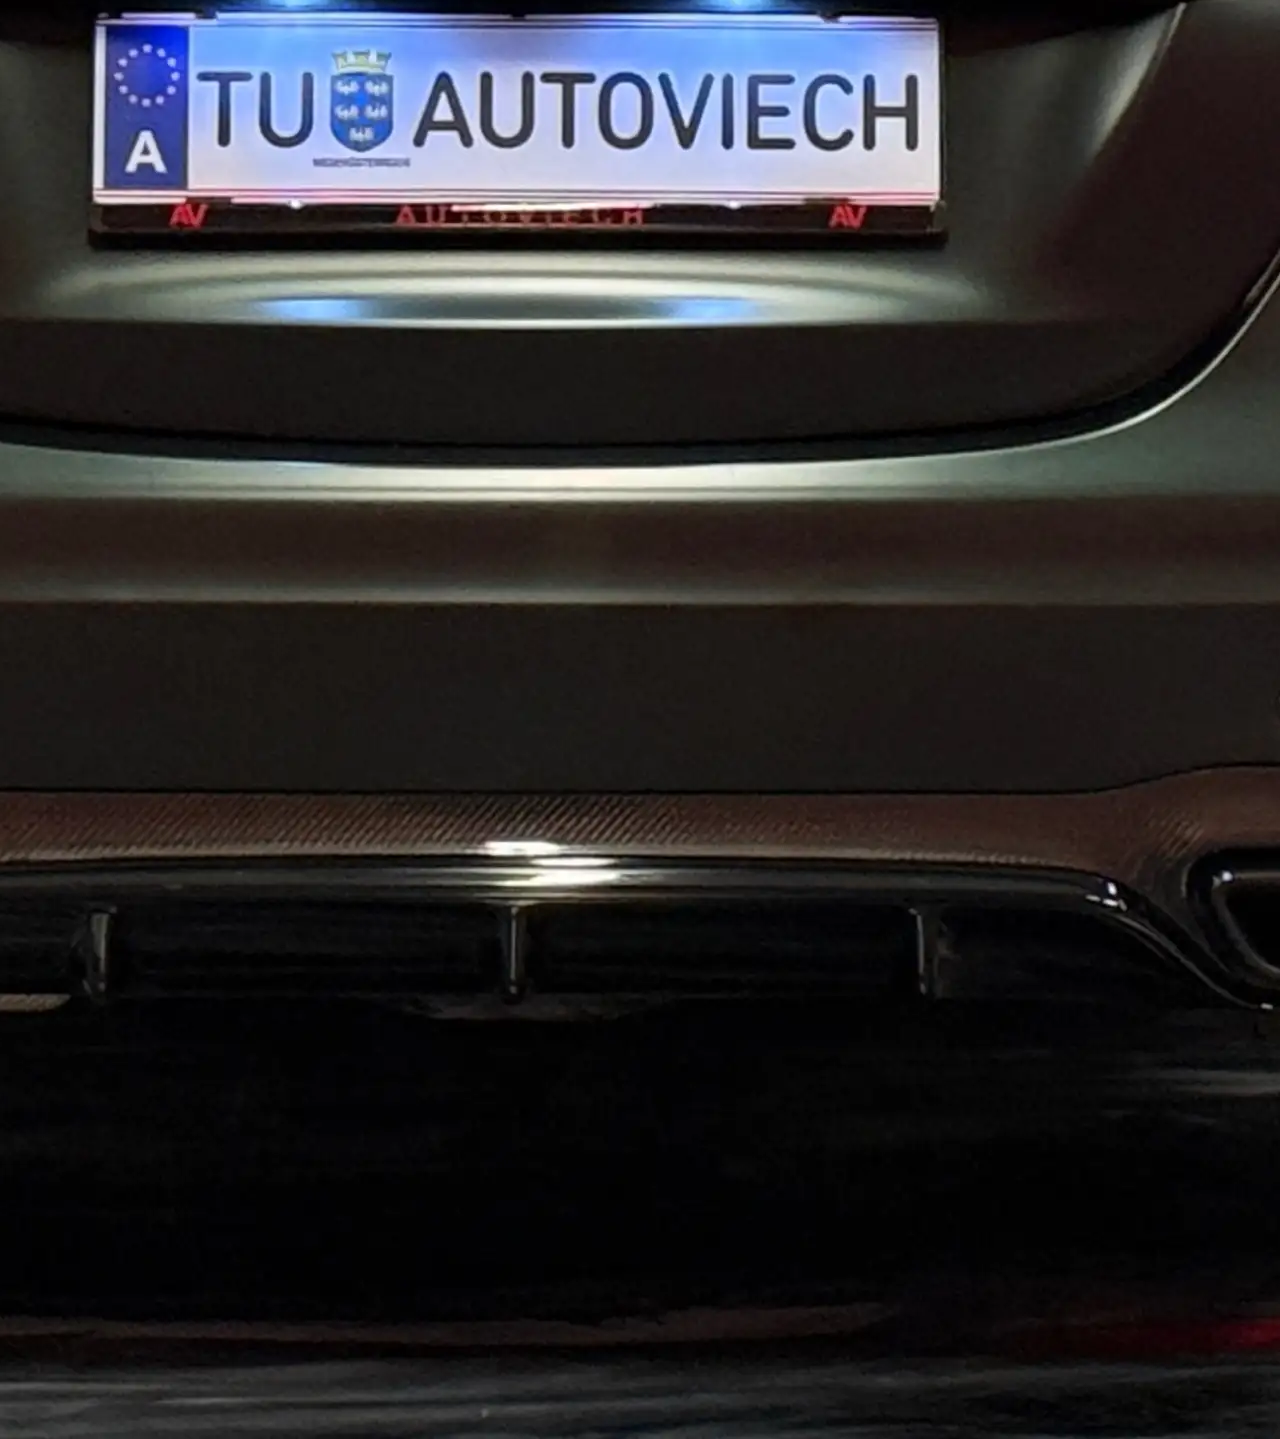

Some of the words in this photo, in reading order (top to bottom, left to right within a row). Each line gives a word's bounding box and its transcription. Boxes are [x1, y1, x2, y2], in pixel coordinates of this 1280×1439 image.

[196, 71, 314, 149] TU
[413, 71, 919, 153] AUTOVIECH
[124, 129, 168, 174] A
[169, 203, 209, 228] AV
[829, 205, 867, 229] AV
